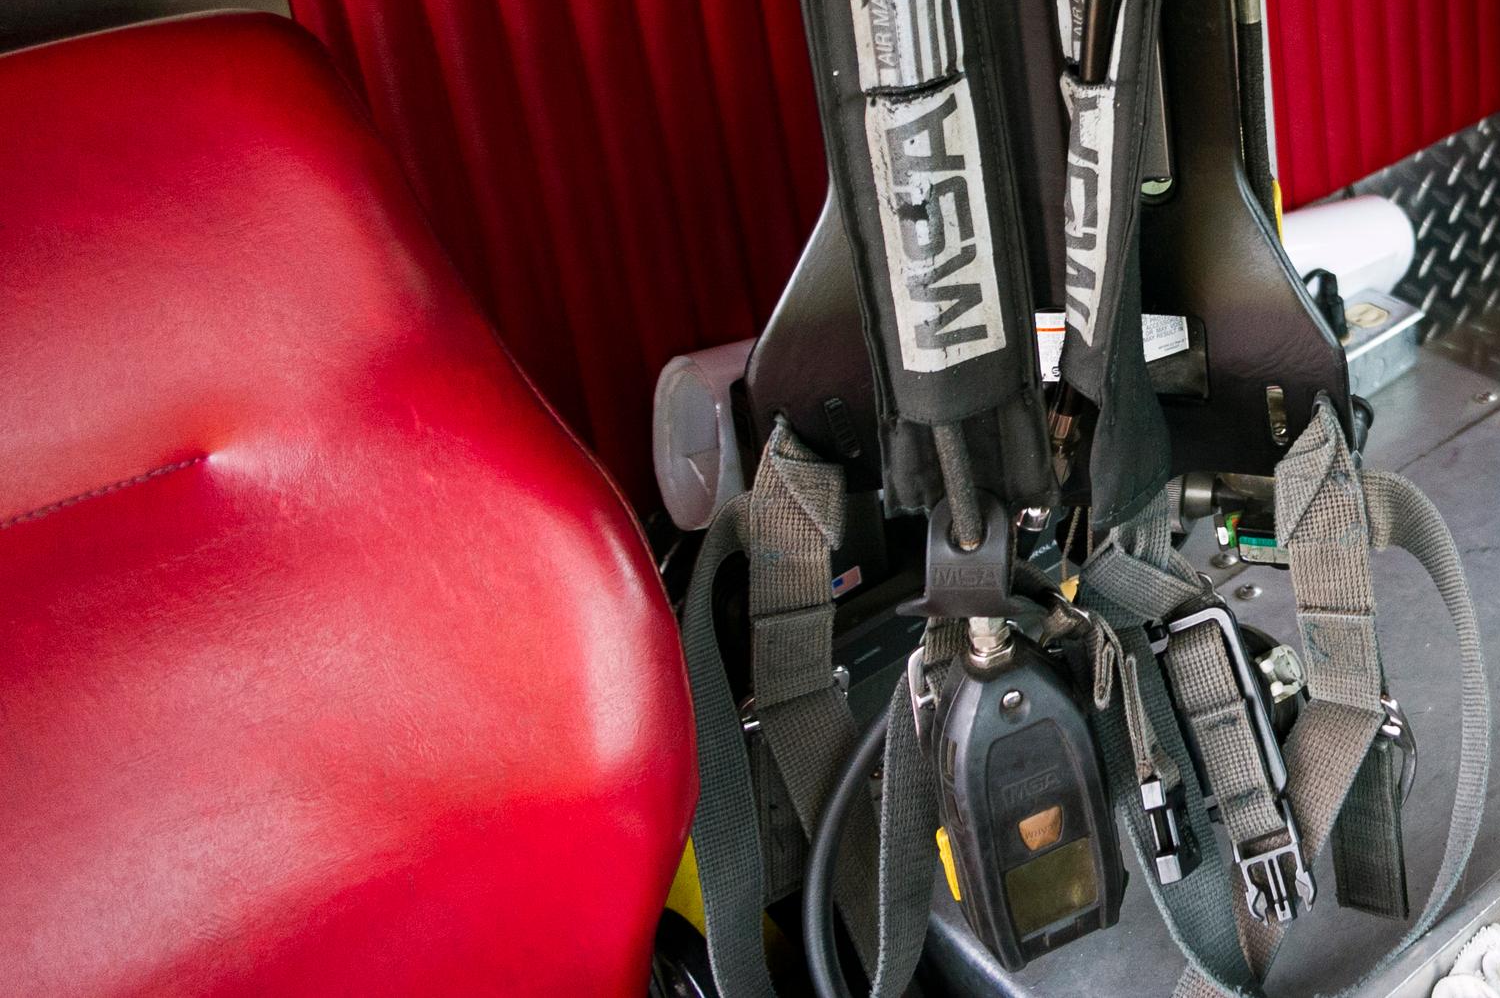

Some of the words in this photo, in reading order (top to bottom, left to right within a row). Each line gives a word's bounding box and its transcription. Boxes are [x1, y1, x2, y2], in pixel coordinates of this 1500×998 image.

[875, 30, 896, 68] AIR
[885, 92, 989, 352] MSA
[934, 567, 1000, 588] MSA
[1003, 771, 1061, 805] MSA
